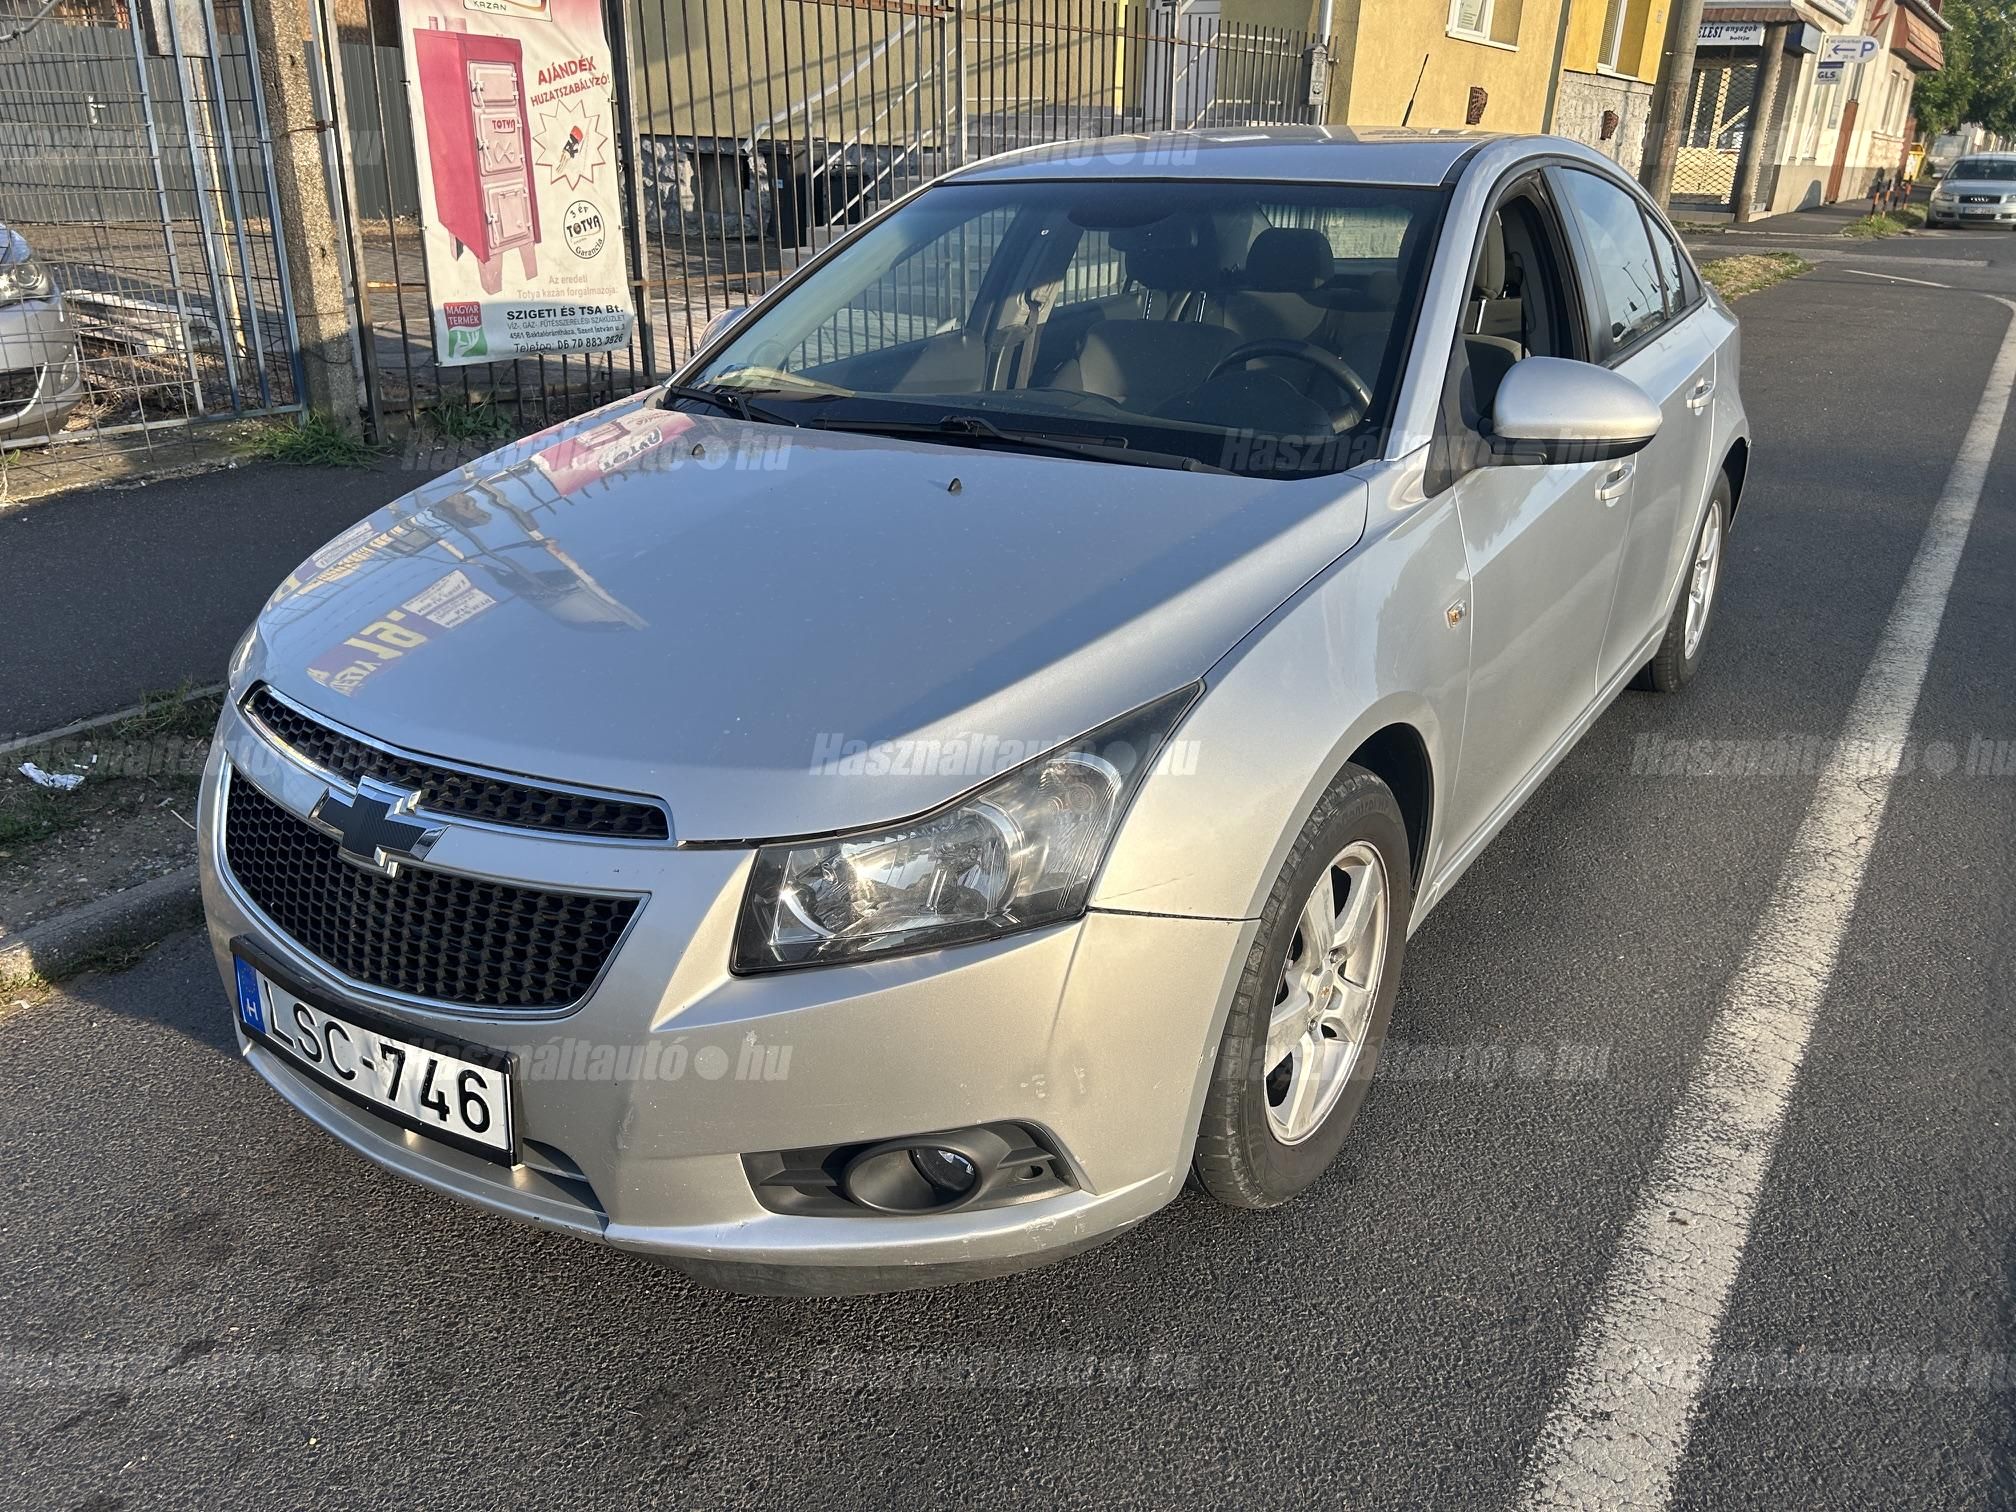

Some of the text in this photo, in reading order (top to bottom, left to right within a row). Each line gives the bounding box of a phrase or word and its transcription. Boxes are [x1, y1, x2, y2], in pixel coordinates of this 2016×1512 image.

[1725, 24, 1758, 33] anyagok
[1859, 41, 1875, 57] P
[537, 54, 597, 86] AJÁNDÉK
[1817, 71, 1836, 79] GLS
[530, 72, 611, 107] HUZATSZABÁLYZÓ!
[492, 119, 516, 129] TOTYA
[566, 215, 601, 238] TOTYA
[575, 238, 603, 257] Garancia
[548, 274, 588, 284] Az eredeti
[517, 289, 541, 300] Totya
[542, 287, 566, 298] kazán
[446, 305, 479, 315] MAGYAR
[506, 304, 624, 320] SZIGETI ÉS TSA Bt.
[448, 316, 480, 325] TERMÉK
[577, 326, 594, 335] Szent
[594, 325, 614, 333] István
[514, 333, 624, 353] Telefon: 06 70 883 3526
[246, 998, 258, 1021] H
[264, 979, 491, 1134] LSC-746
